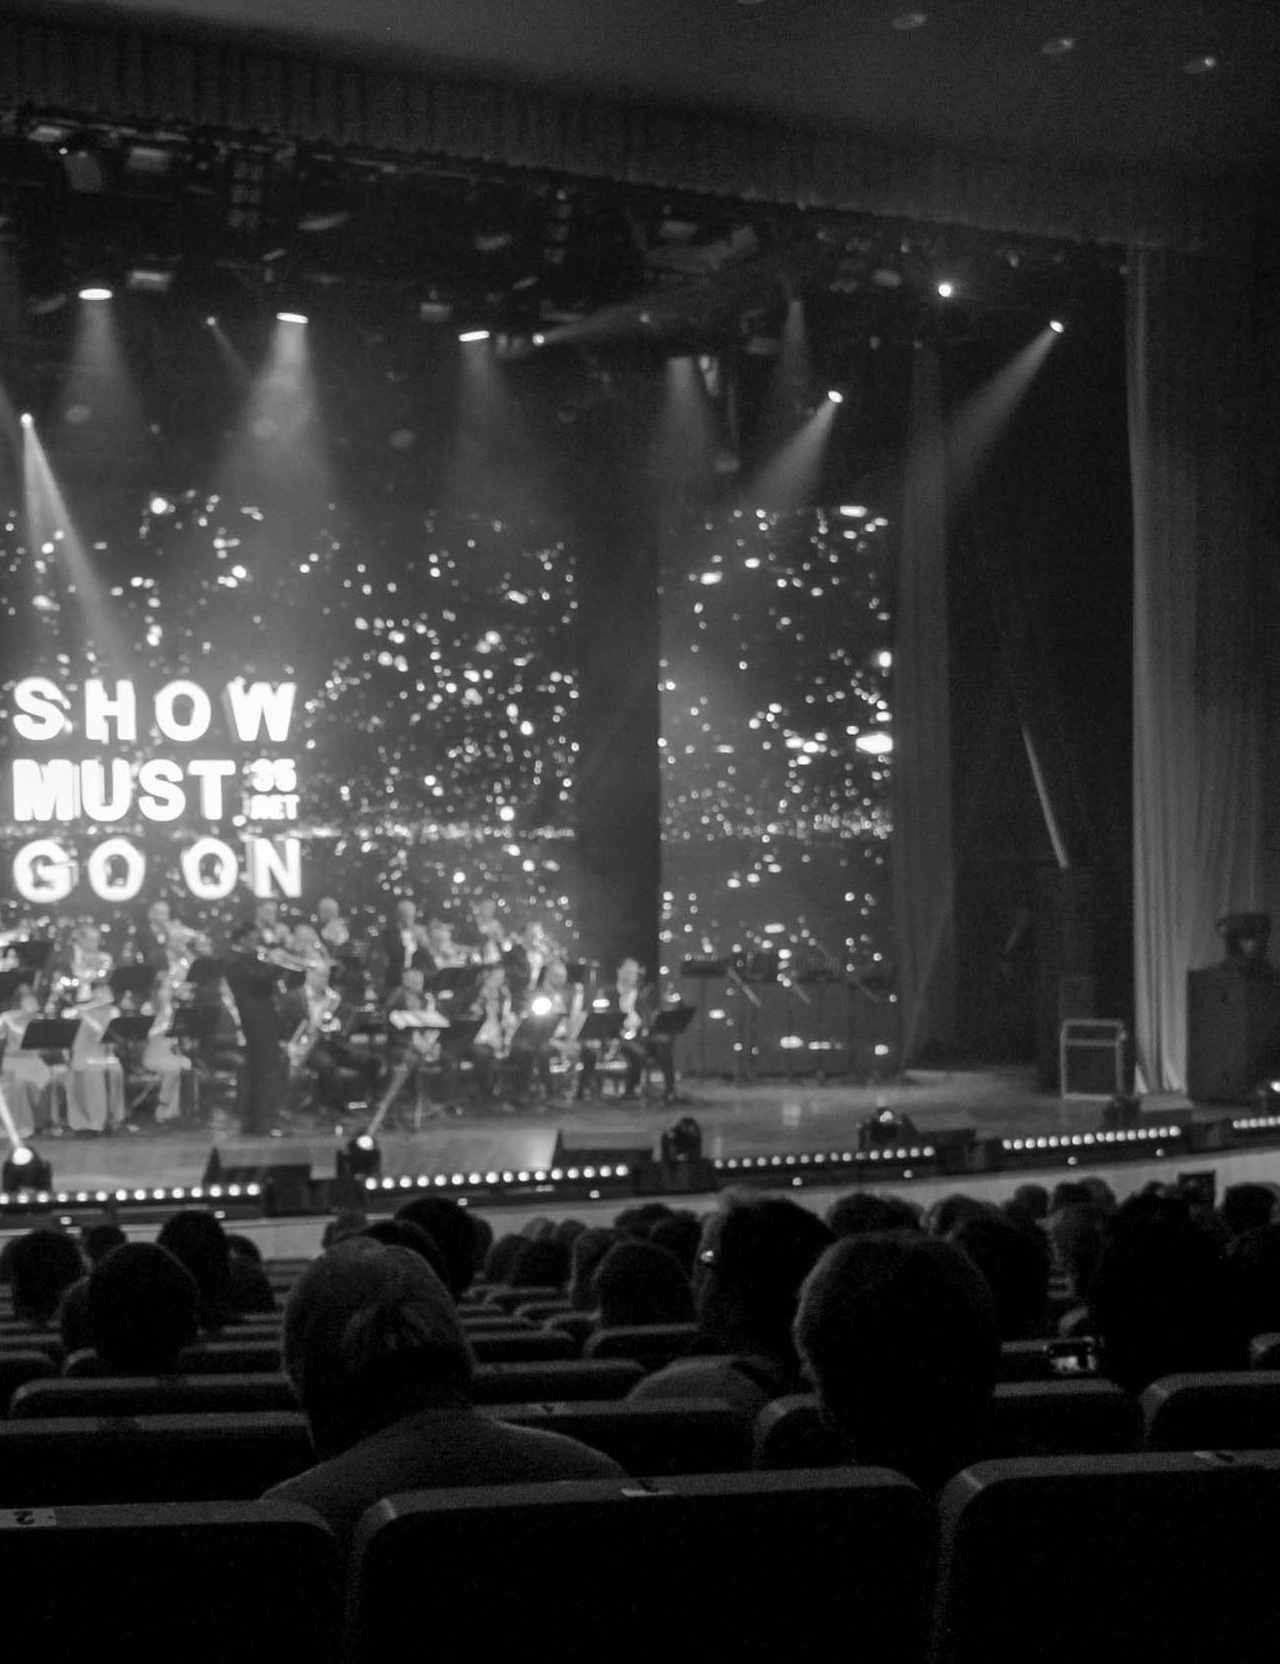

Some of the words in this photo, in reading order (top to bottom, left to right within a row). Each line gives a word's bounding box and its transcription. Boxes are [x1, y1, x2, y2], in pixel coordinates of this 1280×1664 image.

[13, 676, 297, 744] SHOW
[13, 758, 236, 822] MUST
[13, 836, 146, 902] GO
[181, 836, 302, 902] ON
